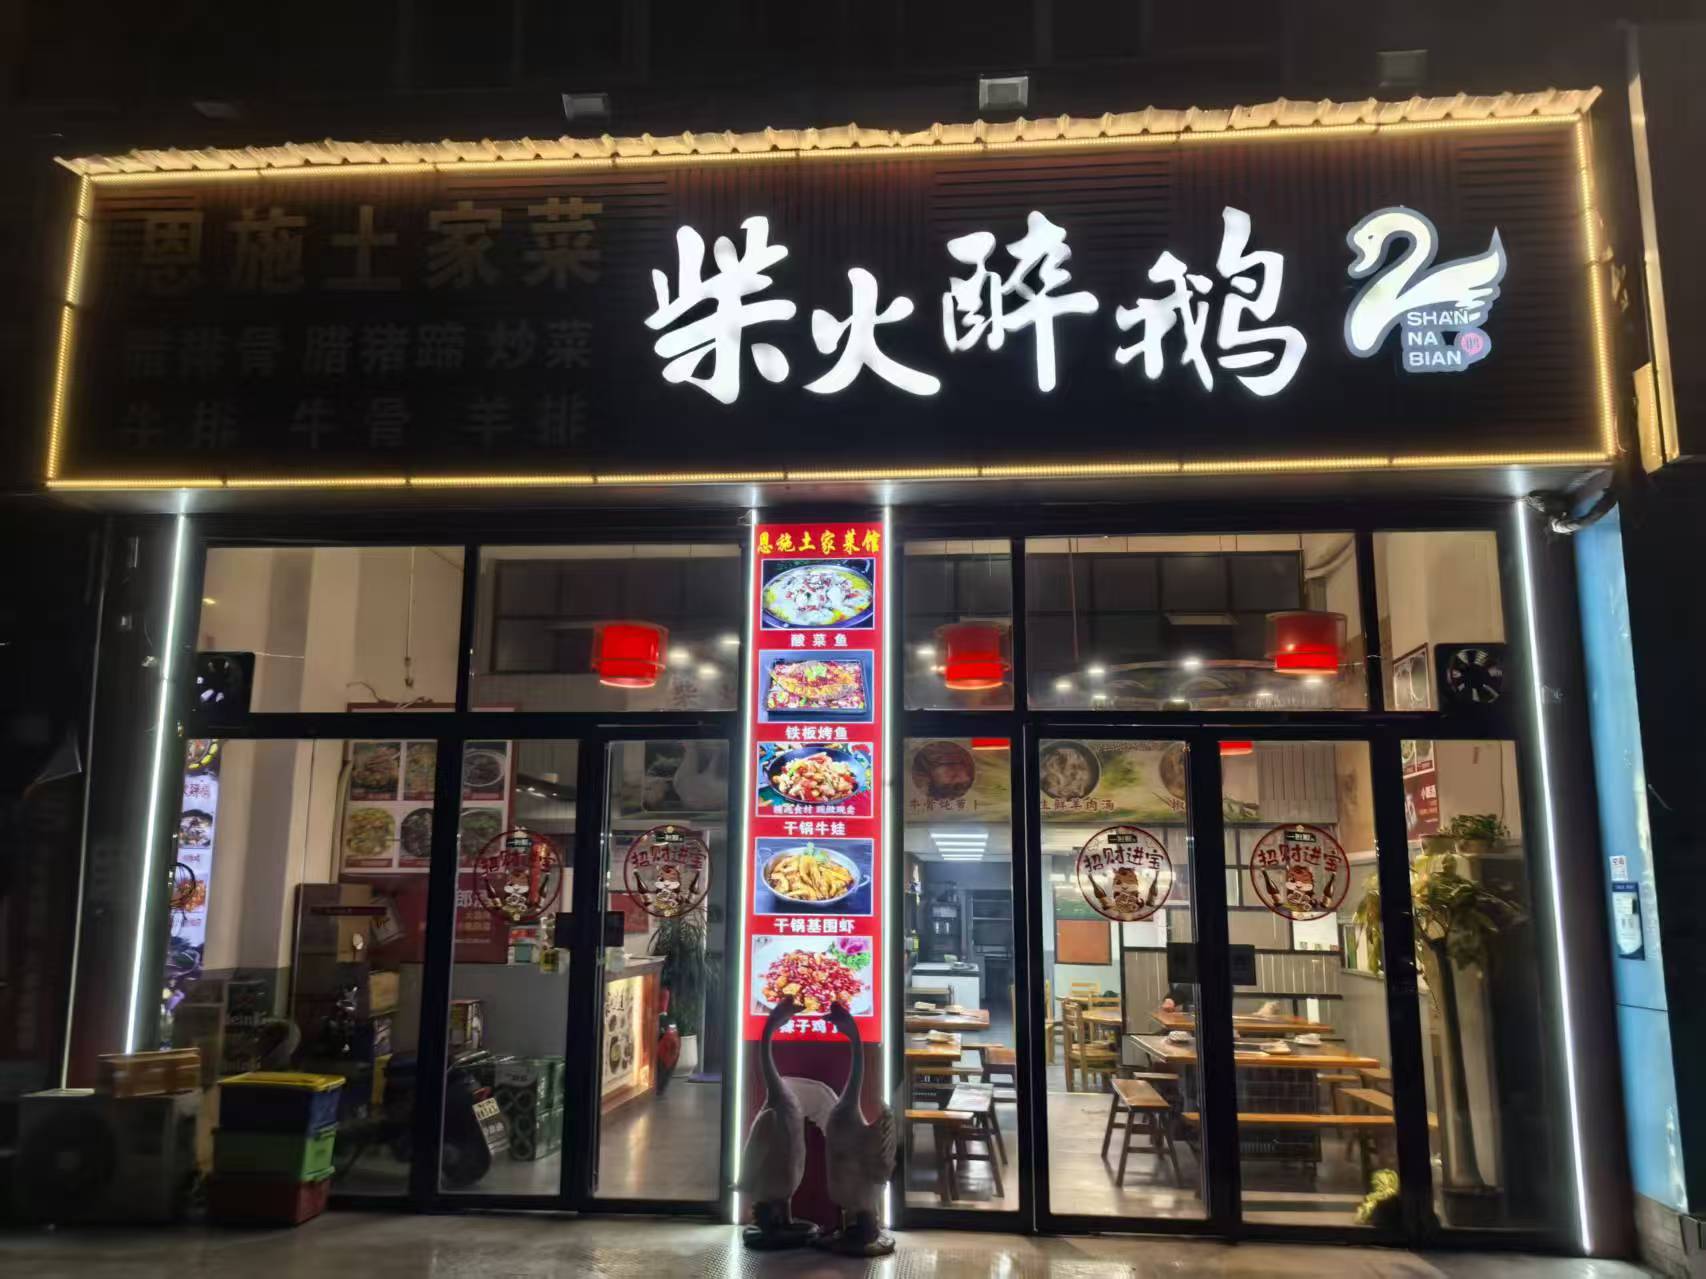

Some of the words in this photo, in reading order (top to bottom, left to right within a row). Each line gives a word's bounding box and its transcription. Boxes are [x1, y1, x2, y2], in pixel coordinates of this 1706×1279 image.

[132, 198, 603, 296] 恩施土家菜
[645, 206, 1308, 404] 柴火醉鹅
[1408, 331, 1438, 346] NA
[1408, 350, 1462, 367] BIAN
[757, 528, 881, 556] 恩施土家菜馆
[790, 633, 848, 648] 酸菜鱼
[785, 726, 848, 741] 铁板烤鱼
[631, 845, 707, 869] 招财进宝
[1083, 845, 1164, 872] 招财进宝
[1258, 844, 1342, 872] 招财进宝
[773, 918, 855, 934] 干锅基围虾
